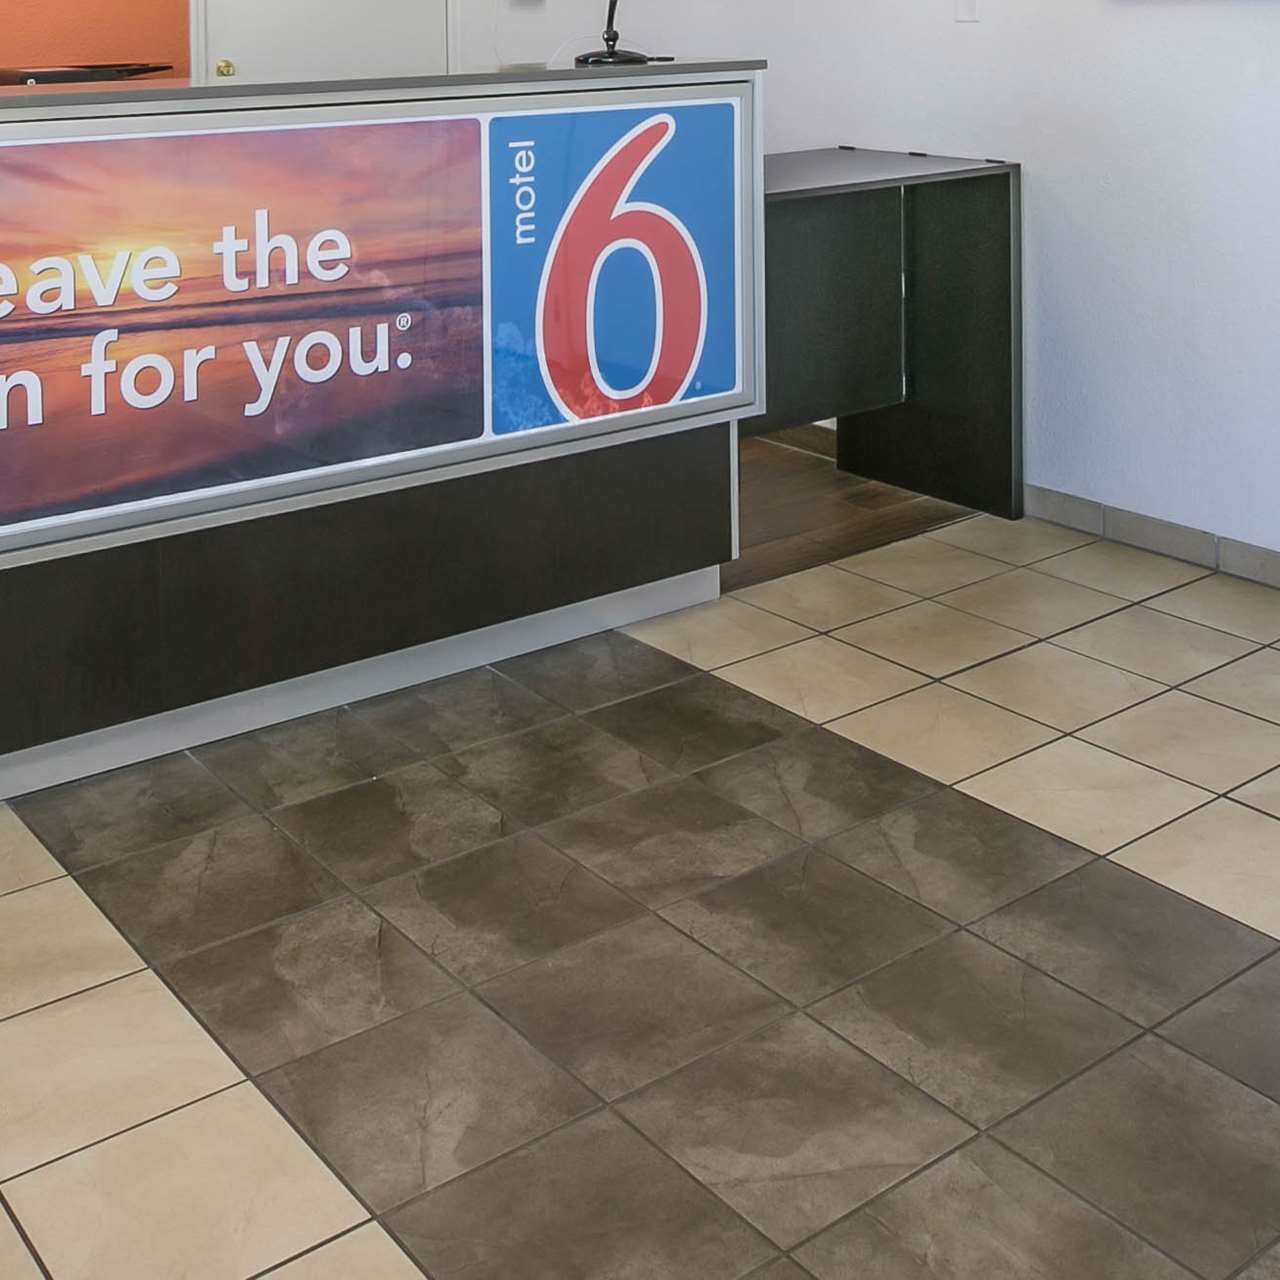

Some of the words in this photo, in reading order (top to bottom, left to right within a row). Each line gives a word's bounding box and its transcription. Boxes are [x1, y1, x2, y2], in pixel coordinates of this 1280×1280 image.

[508, 140, 536, 245] motel
[213, 208, 353, 293] the
[535, 113, 709, 423] 6
[81, 328, 216, 416] for
